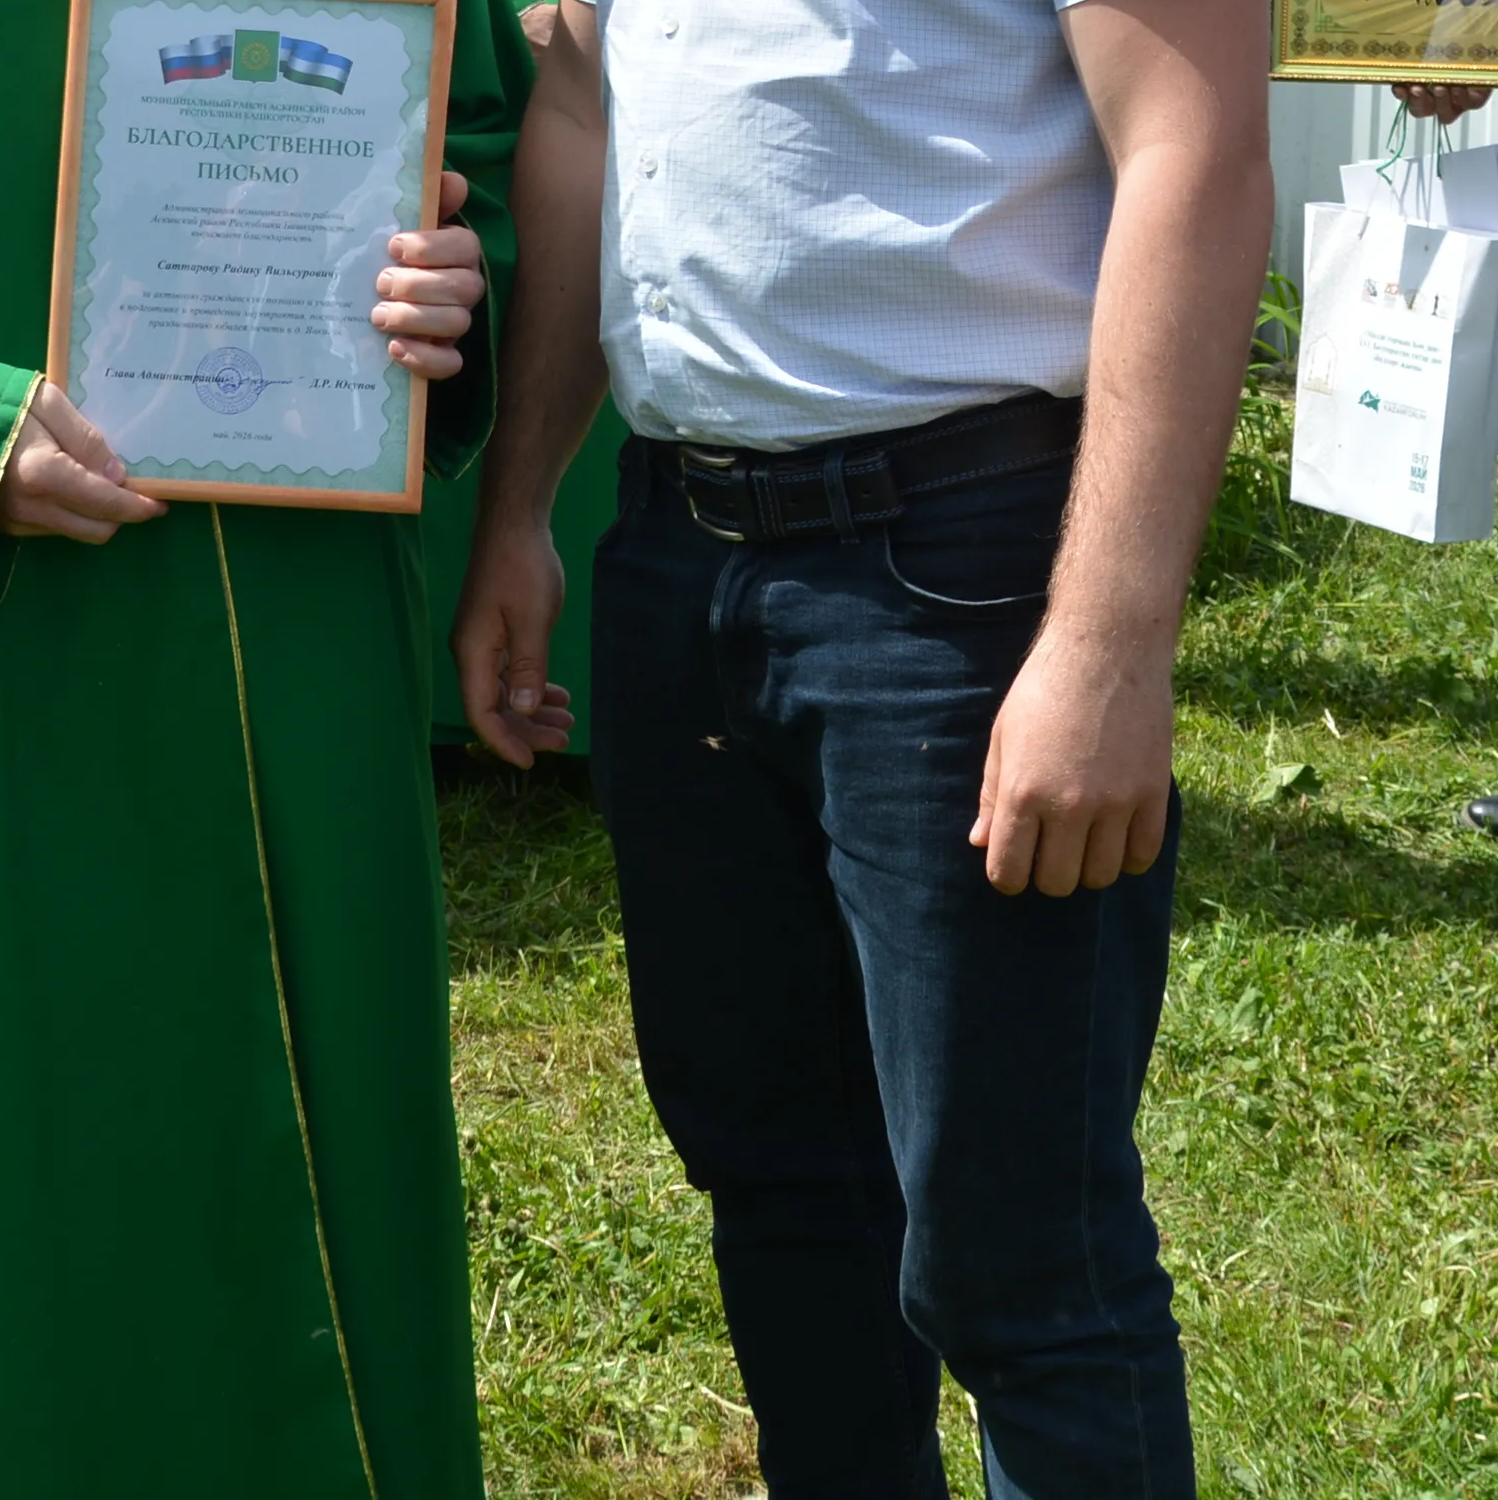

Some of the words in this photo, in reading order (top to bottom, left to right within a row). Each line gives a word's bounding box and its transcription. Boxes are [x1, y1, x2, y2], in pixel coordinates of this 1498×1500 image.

[141, 95, 232, 109] МУНИЦИПАЛЬНЫЙ
[233, 100, 266, 111] РАЙОН
[269, 102, 329, 115] АСКИНСКИЙ
[331, 106, 365, 117] РАЙОН
[179, 108, 241, 119] РЕСПУБЛИКИ
[244, 112, 325, 124] БАШКОРТОСТАН
[127, 126, 375, 158] БЛАГОДАРСТВЕННОЕ
[197, 161, 299, 184] ПИСЬМО
[162, 203, 236, 218] Администрация
[237, 208, 312, 221] муниципального
[150, 215, 198, 227] Аскинский
[198, 219, 228, 230] район
[228, 219, 281, 232] Республики
[283, 222, 355, 234] Башкортостан
[190, 230, 242, 242] выражает
[157, 259, 222, 276] Саттарову
[223, 263, 262, 278] Радику
[265, 265, 339, 282] Вильсуровичу
[153, 291, 199, 303] активную
[265, 297, 305, 309] позицию
[127, 303, 180, 316] подготовке
[148, 318, 213, 331] празднованию
[215, 321, 248, 333] юбилея
[104, 367, 136, 380] Глава
[139, 369, 227, 386] Администрации
[308, 378, 332, 390] Д.Р.
[334, 378, 377, 393] Юсупов
[254, 434, 273, 443] года
